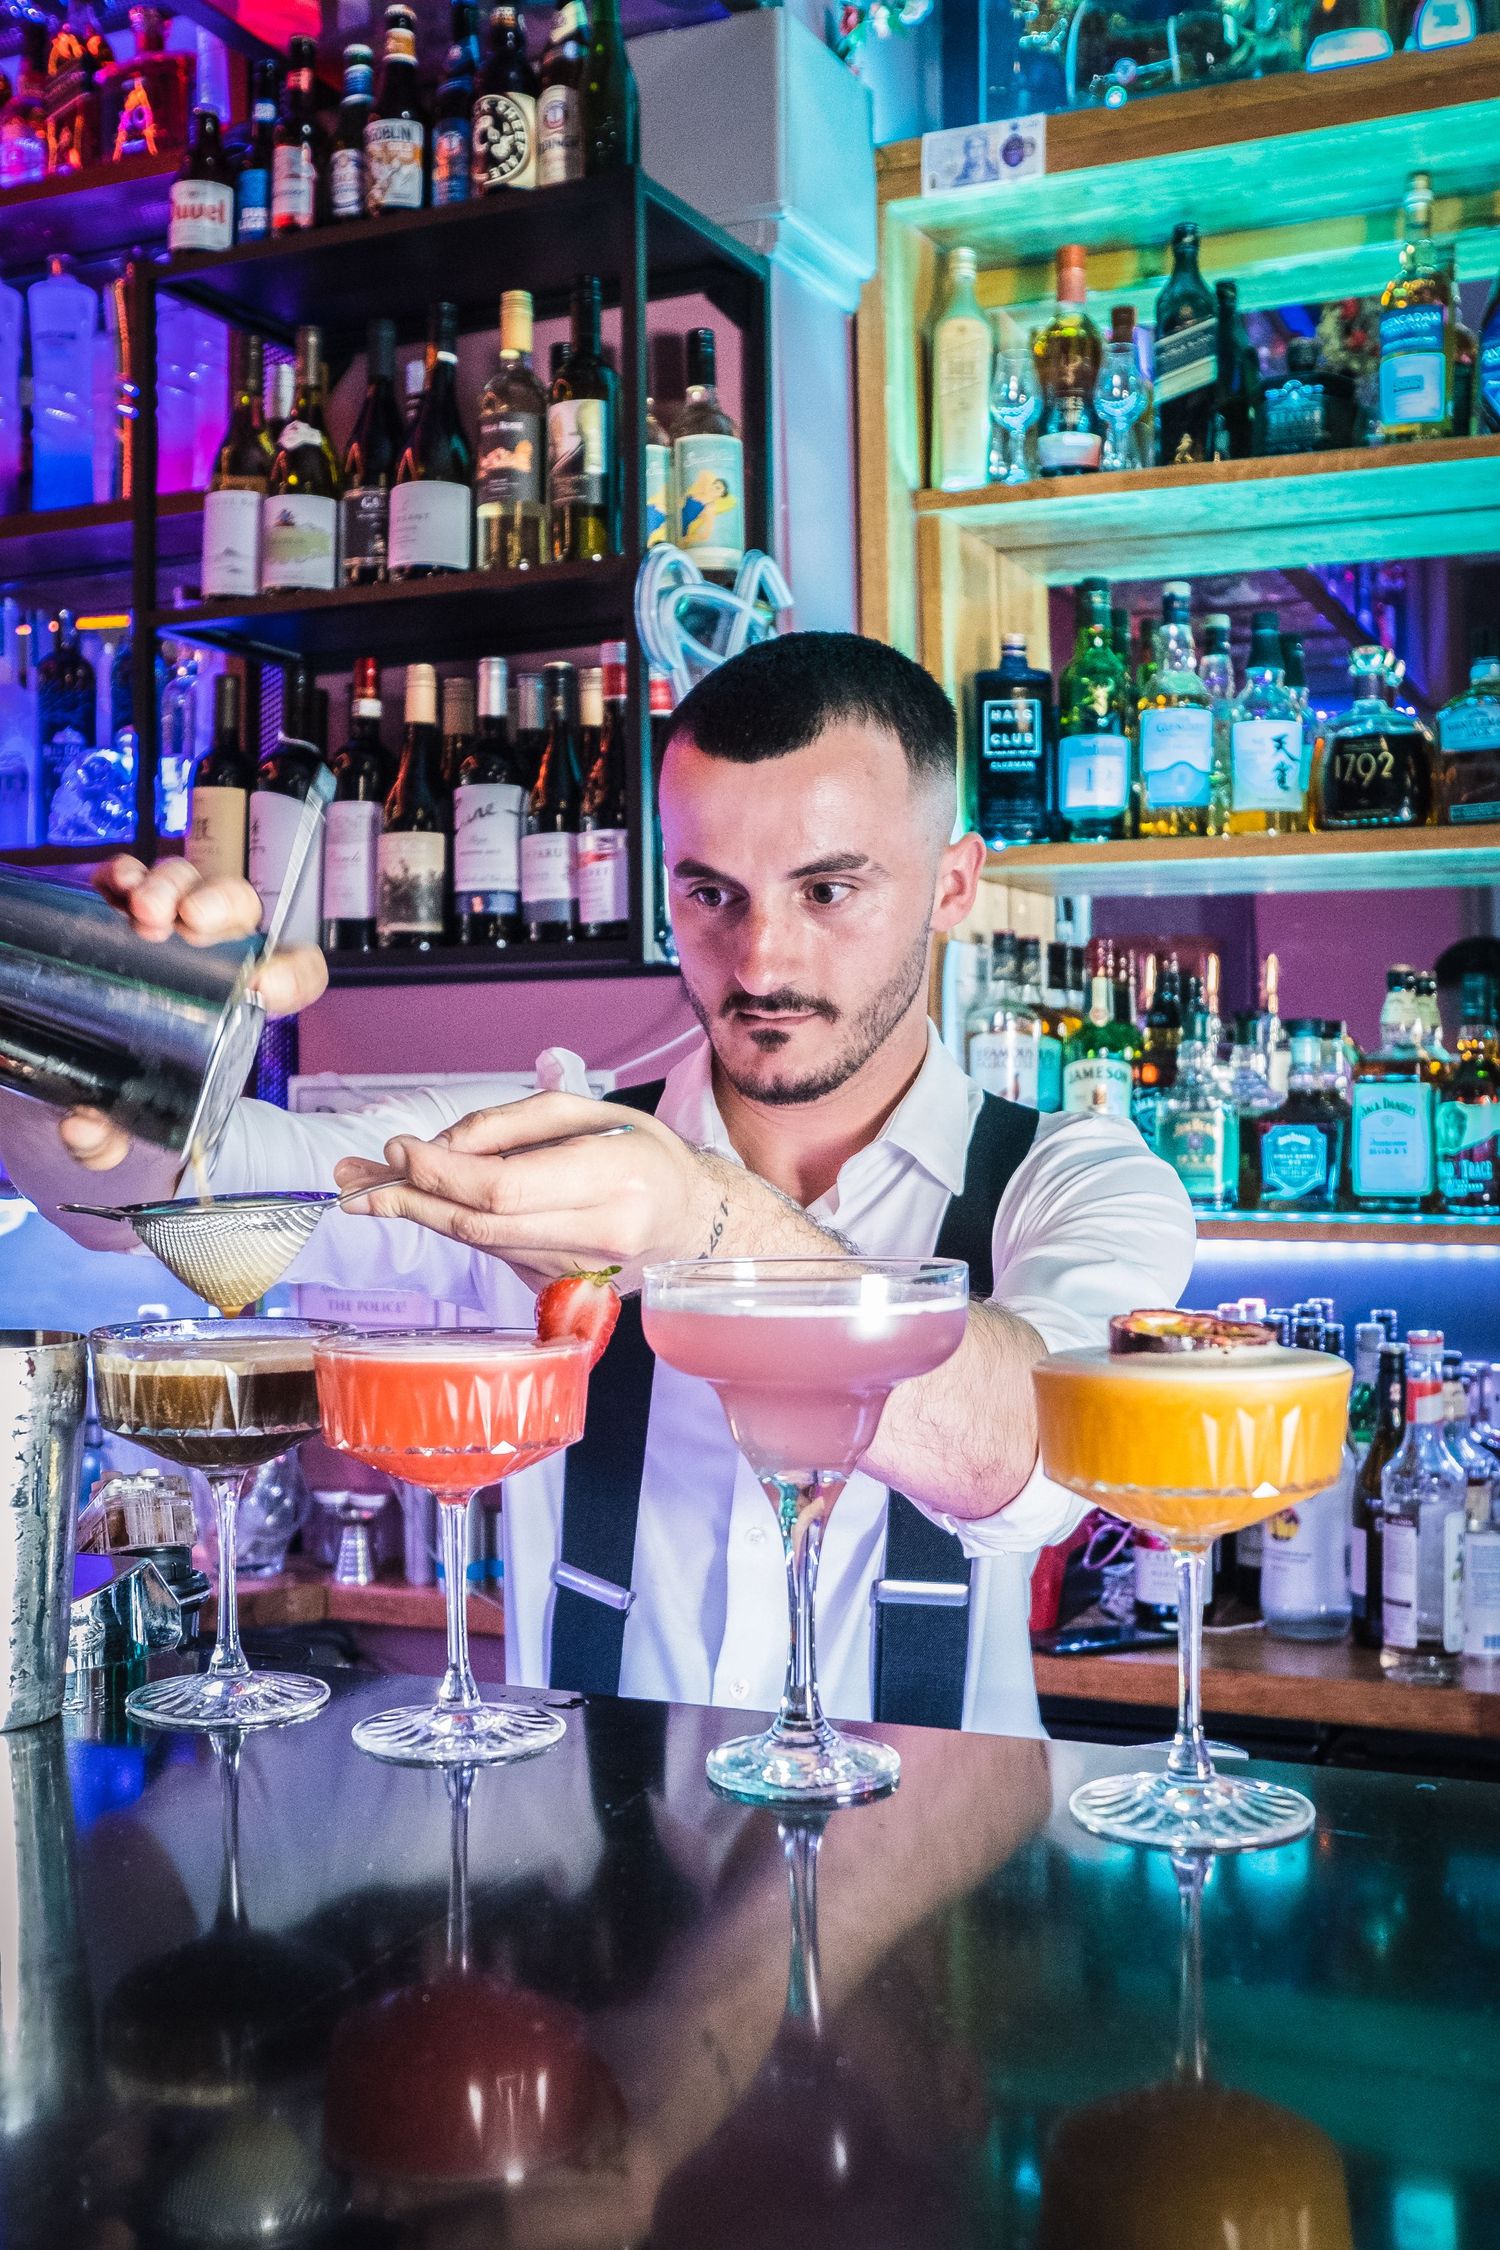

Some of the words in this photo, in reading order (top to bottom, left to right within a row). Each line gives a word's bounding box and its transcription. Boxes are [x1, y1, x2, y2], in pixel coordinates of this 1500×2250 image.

[990, 732, 1034, 745] CLUB
[1334, 751, 1395, 786] 1792
[1068, 1065, 1127, 1086] JAMESON
